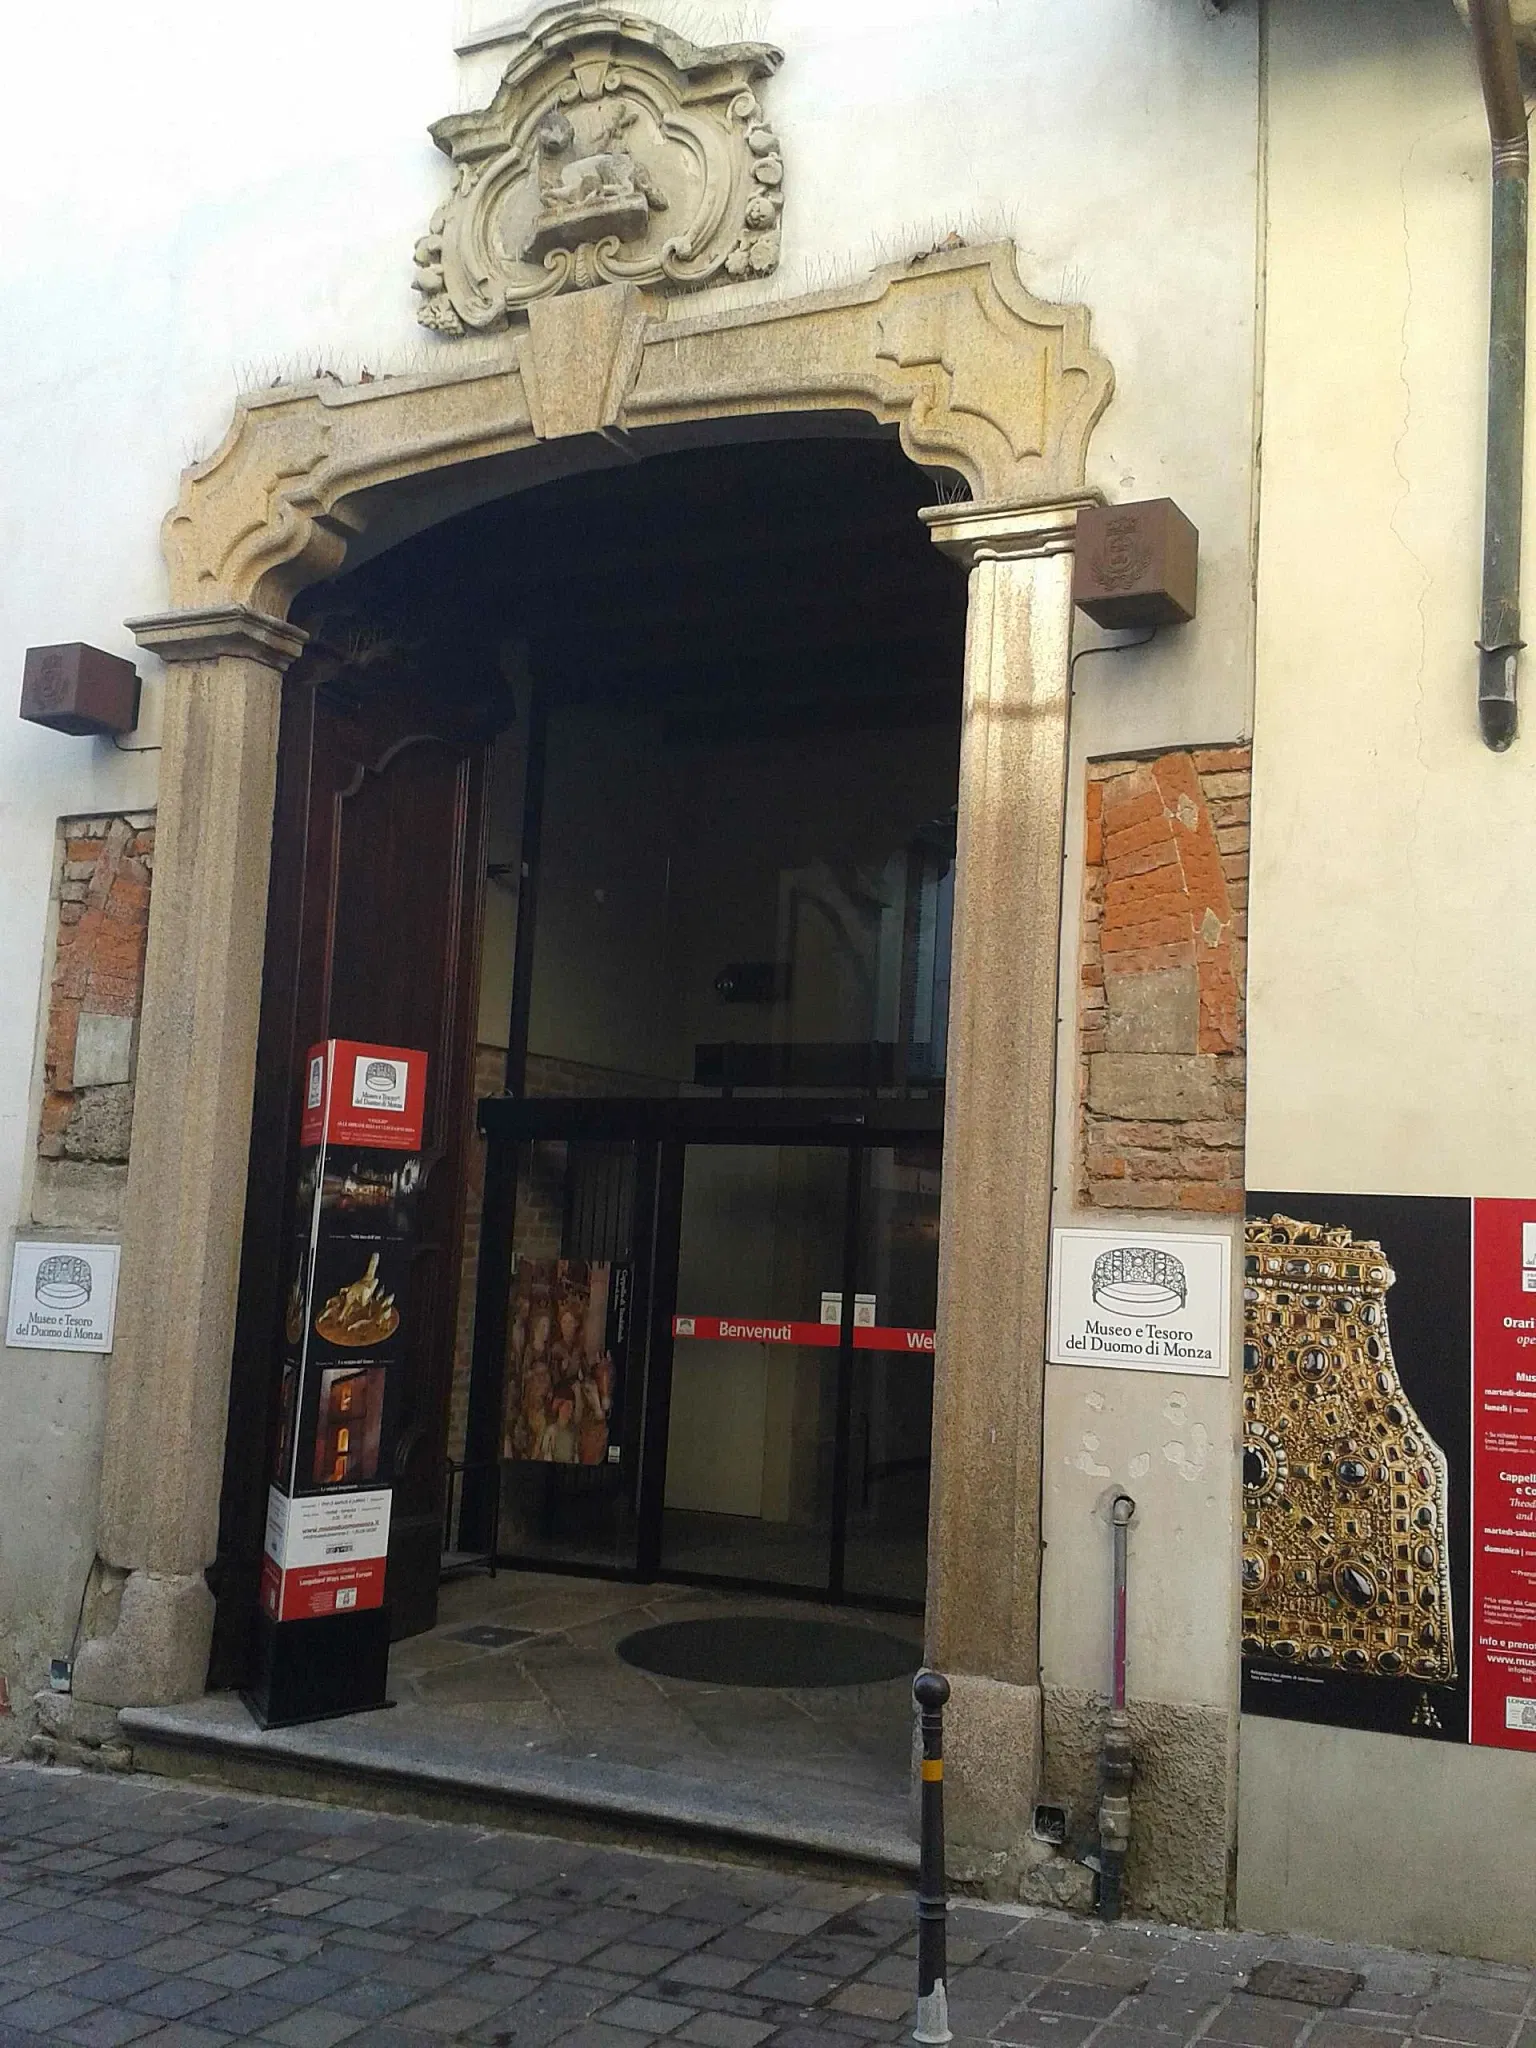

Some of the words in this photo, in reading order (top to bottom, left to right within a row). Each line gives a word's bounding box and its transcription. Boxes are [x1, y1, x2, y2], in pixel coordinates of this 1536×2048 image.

[28, 1312, 57, 1325] Museo
[58, 1317, 64, 1325] e
[64, 1314, 93, 1327] Tesoro
[1503, 1317, 1535, 1329] Orari
[15, 1324, 29, 1335] del
[31, 1325, 62, 1338] Duomo
[63, 1327, 74, 1338] di
[74, 1328, 103, 1340] Monza
[719, 1321, 792, 1340] Benvenuti
[1085, 1320, 1132, 1338] Museo
[1135, 1327, 1144, 1338] e
[1145, 1324, 1193, 1341] Tesoro
[1065, 1335, 1086, 1350] del
[1091, 1337, 1142, 1355] Duomo
[1145, 1340, 1160, 1356] di
[1163, 1342, 1212, 1359] Monza
[1515, 1487, 1523, 1495] e
[1515, 1511, 1533, 1521] and
[1484, 1544, 1520, 1555] domenica
[1479, 1635, 1498, 1647] info
